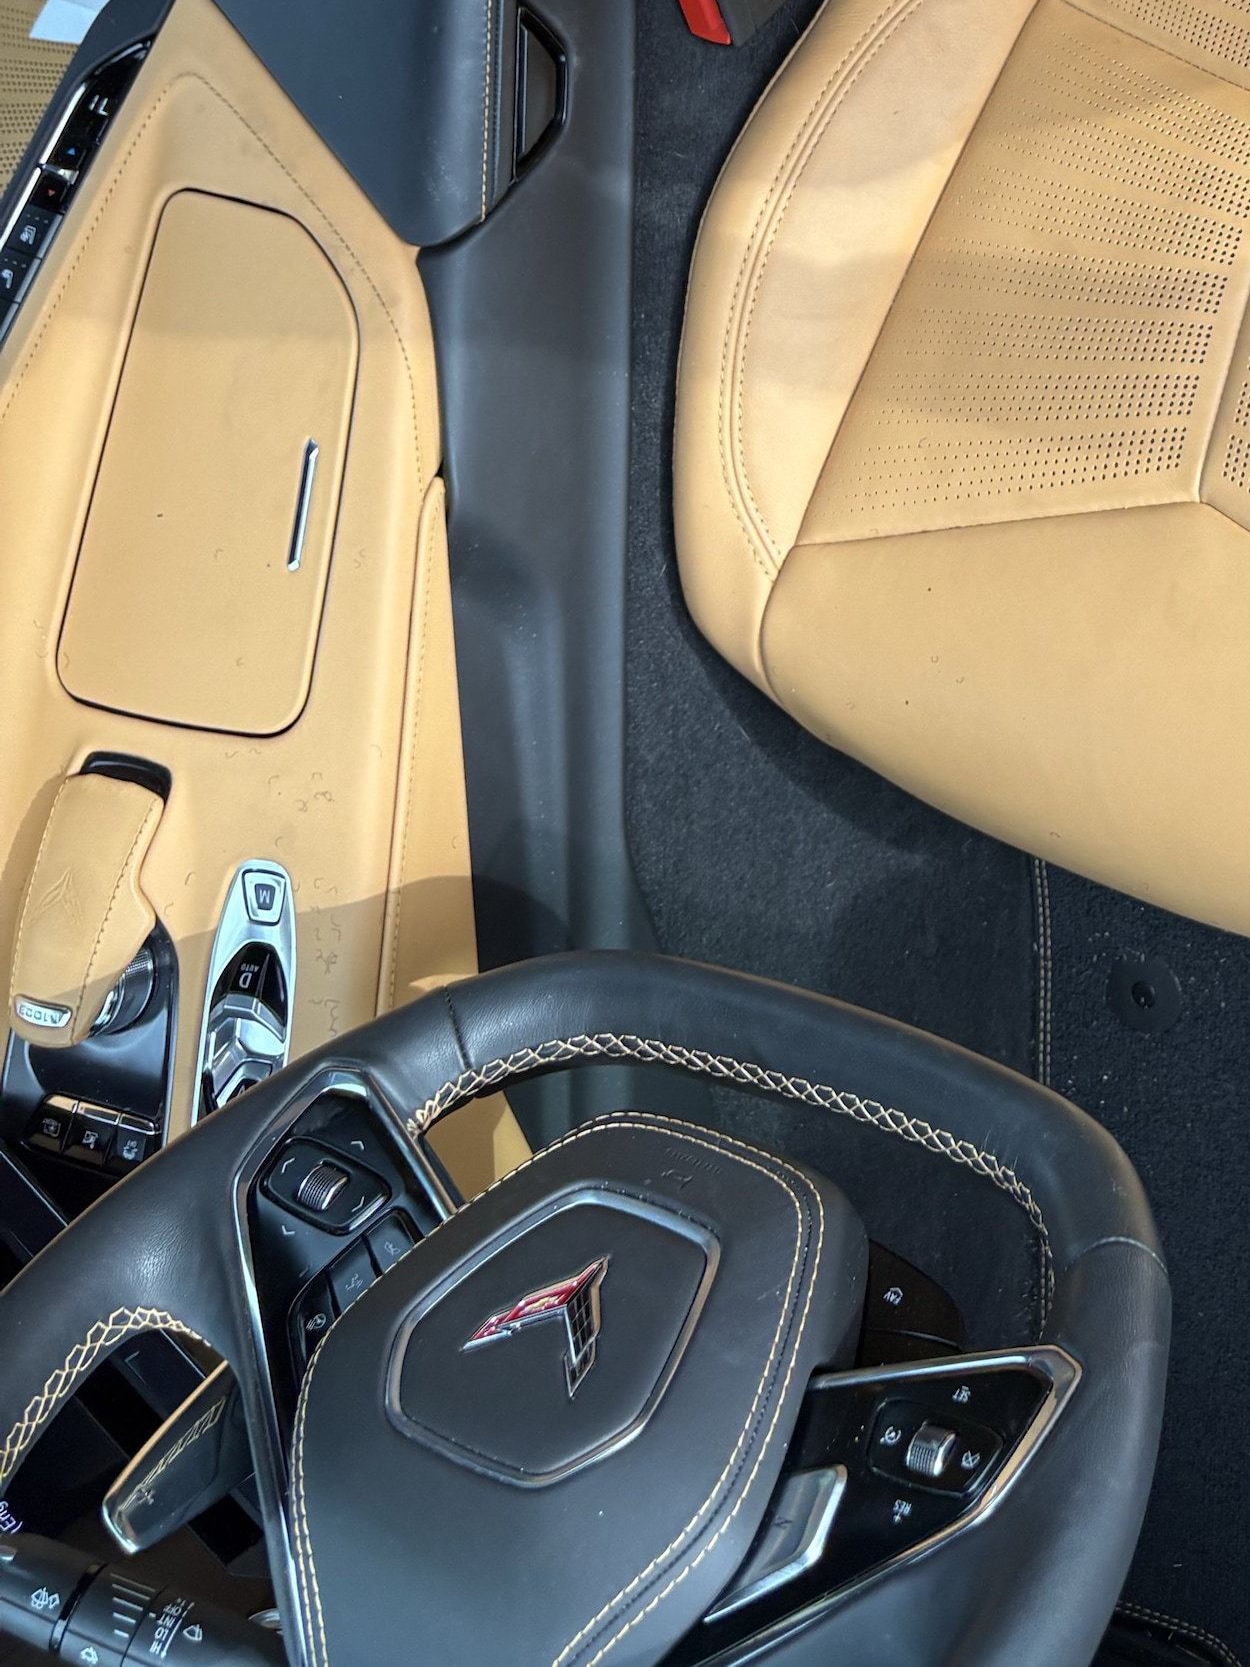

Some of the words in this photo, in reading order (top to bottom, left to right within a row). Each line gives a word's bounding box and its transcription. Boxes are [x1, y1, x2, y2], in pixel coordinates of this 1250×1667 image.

[259, 888, 271, 904] M
[240, 962, 260, 973] AUTO
[239, 972, 252, 989] D
[893, 1499, 912, 1515] RES
[163, 1603, 182, 1616] OFF
[156, 1613, 176, 1628] INT
[154, 1626, 169, 1641] LO
